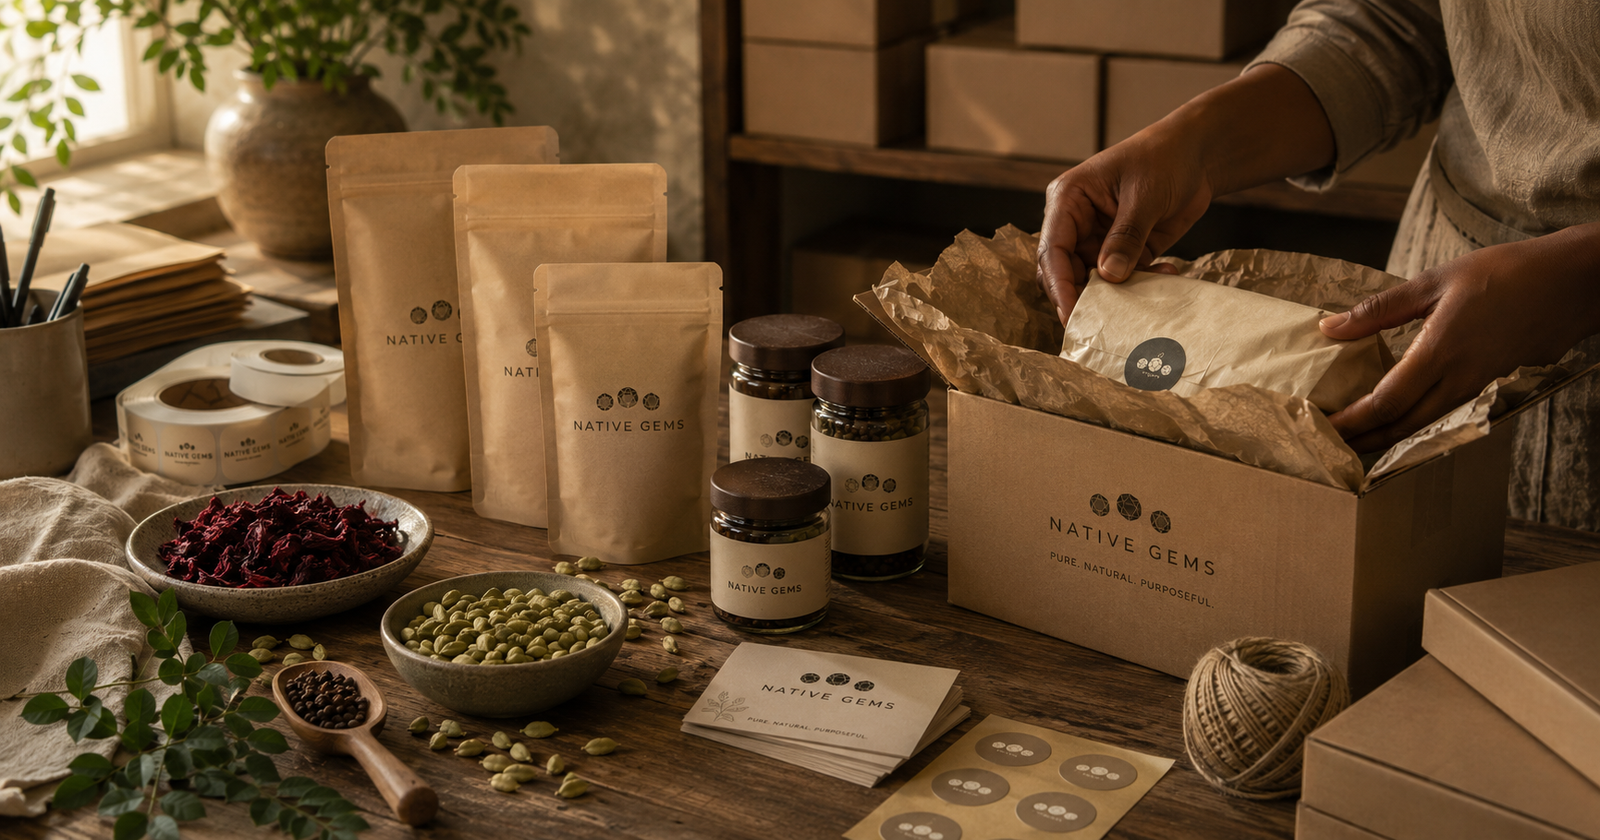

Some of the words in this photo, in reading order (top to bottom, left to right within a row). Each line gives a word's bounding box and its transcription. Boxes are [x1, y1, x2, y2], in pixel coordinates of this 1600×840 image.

[386, 333, 448, 346] NATIVE
[504, 366, 539, 378] NATI
[573, 420, 632, 432] NATIVE
[640, 419, 685, 432] GEMS
[164, 450, 189, 459] NATIVE
[191, 452, 213, 460] GEMS
[224, 448, 250, 458] NATIVE
[252, 443, 271, 454] GEMS
[880, 497, 913, 512] GEMS
[1050, 516, 1135, 553] NATIVE
[1148, 544, 1215, 576] GEMS
[727, 580, 766, 595] NATIVE
[770, 584, 803, 595] GEMS
[1050, 551, 1080, 568] PURE.
[1084, 561, 1137, 585] NATURAL.
[1140, 578, 1215, 609] PURPOSEFUL.
[761, 684, 833, 701] NATIVE
[841, 695, 896, 710] GEMS
[772, 720, 811, 731] NATURAL.
[814, 726, 868, 740] PURPOSEFUL.
